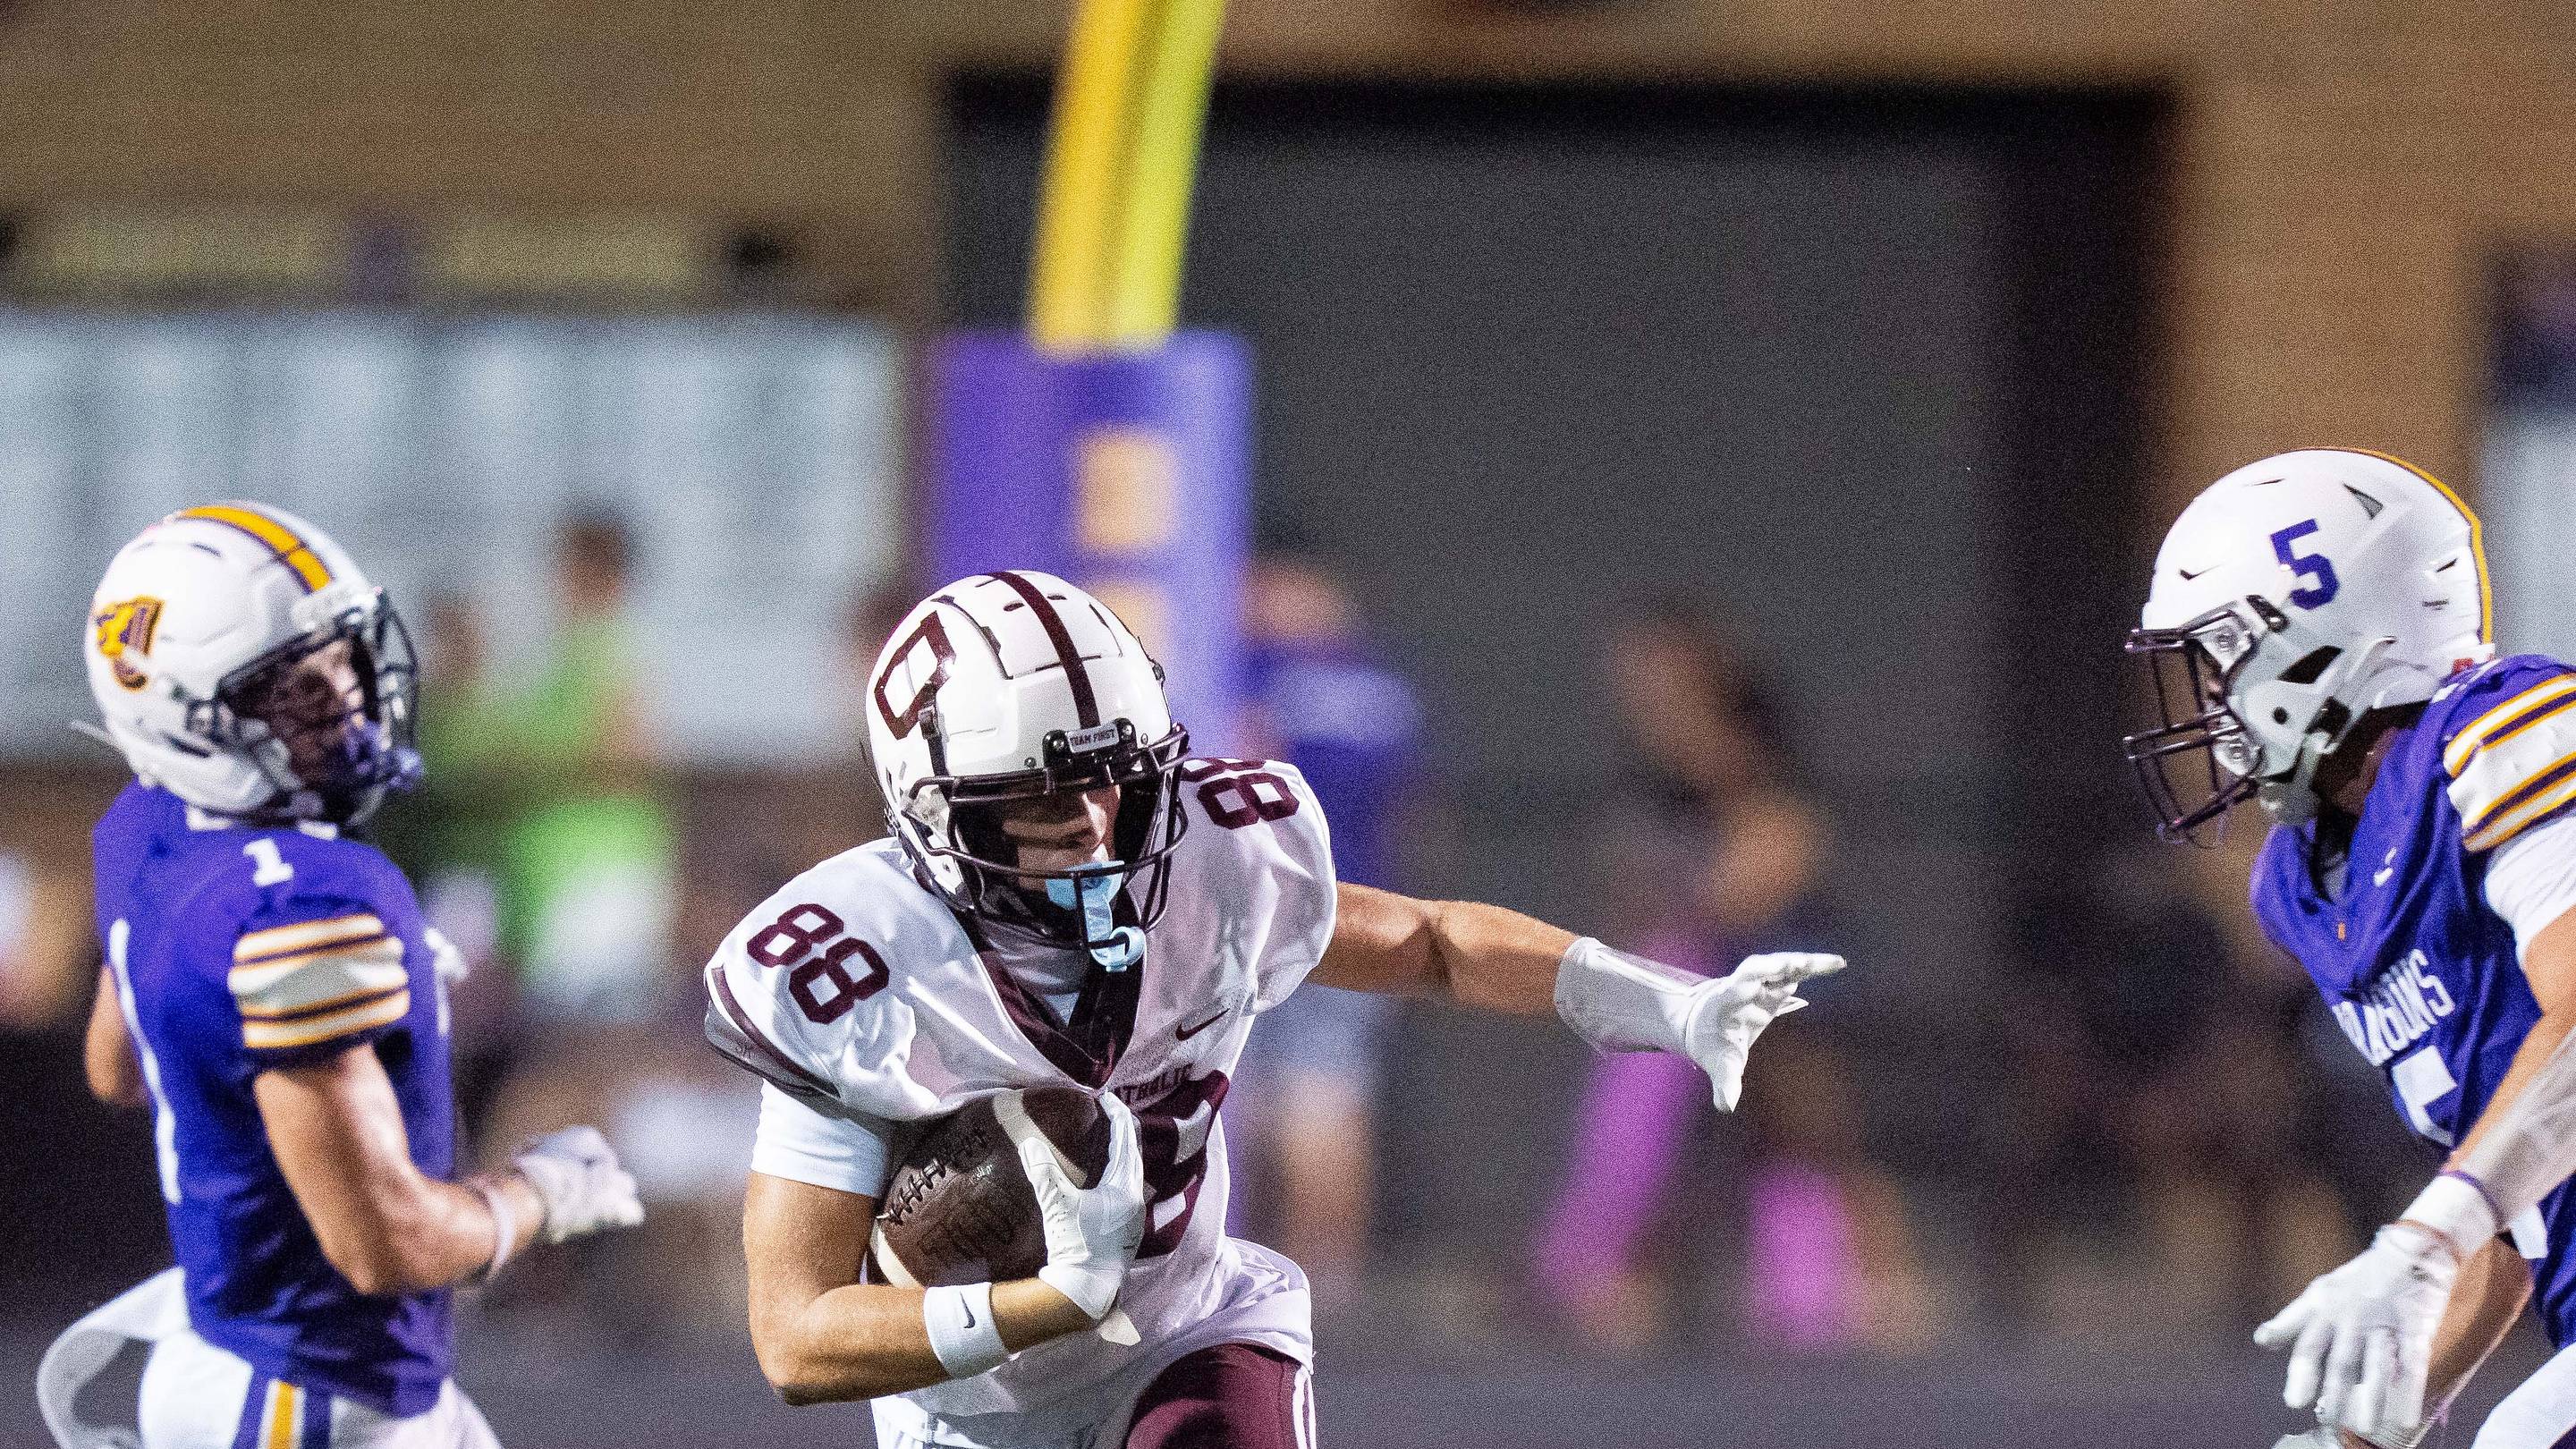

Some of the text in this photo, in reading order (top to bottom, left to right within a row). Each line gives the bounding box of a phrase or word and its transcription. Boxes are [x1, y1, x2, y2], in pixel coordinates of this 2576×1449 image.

[2270, 518, 2341, 611] 5
[1069, 729, 1115, 746] TEAM FIRST
[243, 838, 293, 886] 1
[746, 902, 890, 1025] 88
